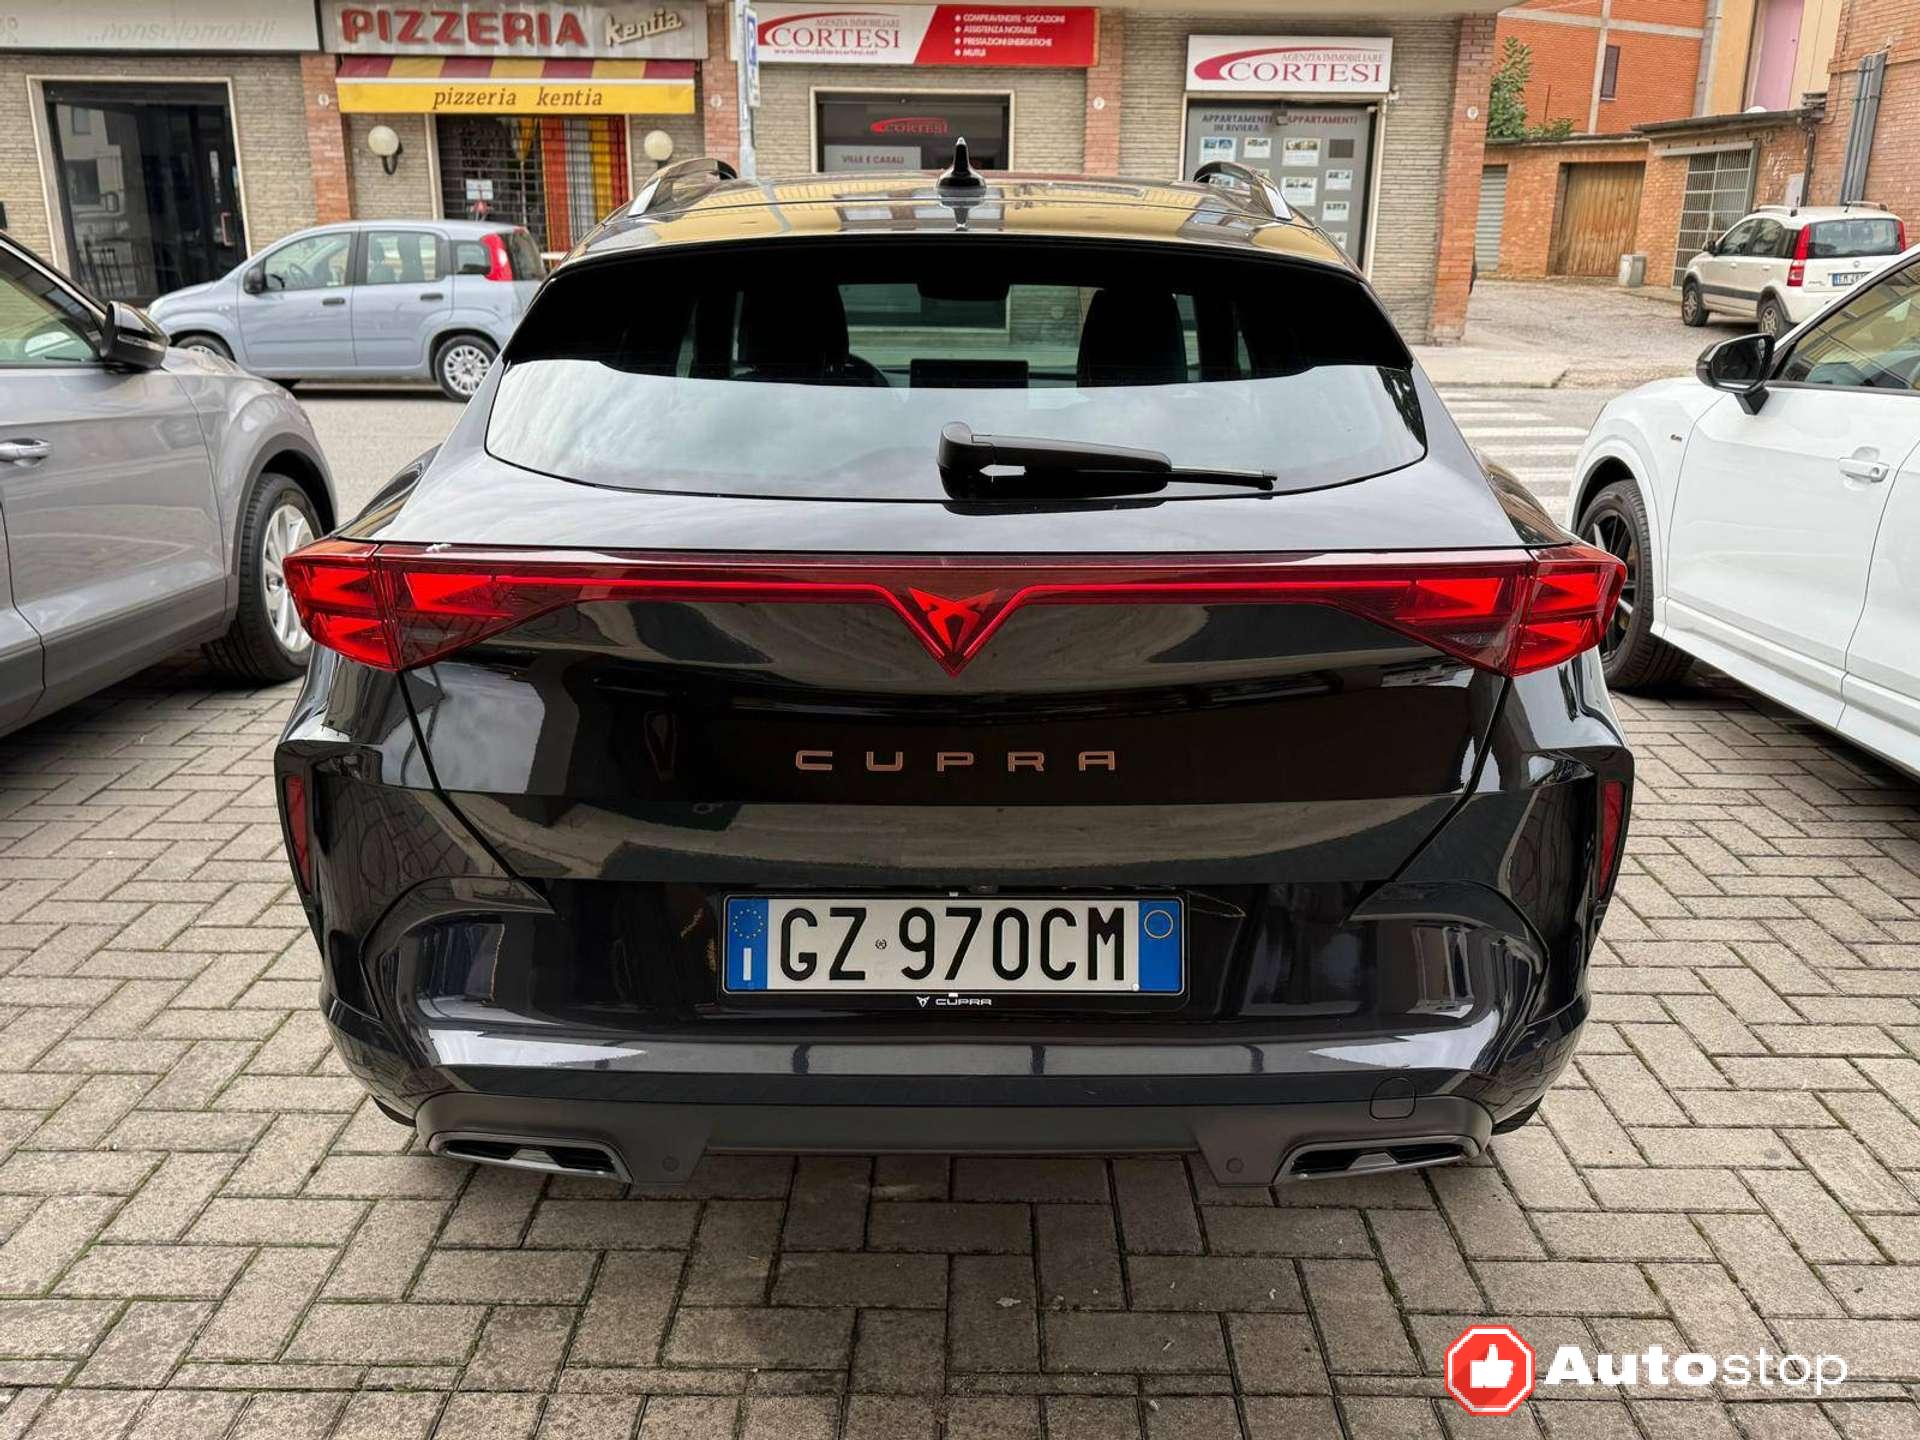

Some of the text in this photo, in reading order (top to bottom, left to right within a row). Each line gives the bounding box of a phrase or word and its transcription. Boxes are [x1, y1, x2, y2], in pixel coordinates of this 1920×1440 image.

[342, 8, 588, 48] PIZZERIA
[605, 8, 684, 47] kentia
[772, 28, 900, 48] CORTESI
[1228, 62, 1381, 82] CORTESI
[432, 87, 604, 110] pizzeria kentia
[795, 750, 1116, 772] CUPRA
[780, 907, 867, 981] GZ
[899, 907, 1125, 981] 970CM
[935, 998, 993, 1007] CUPRA
